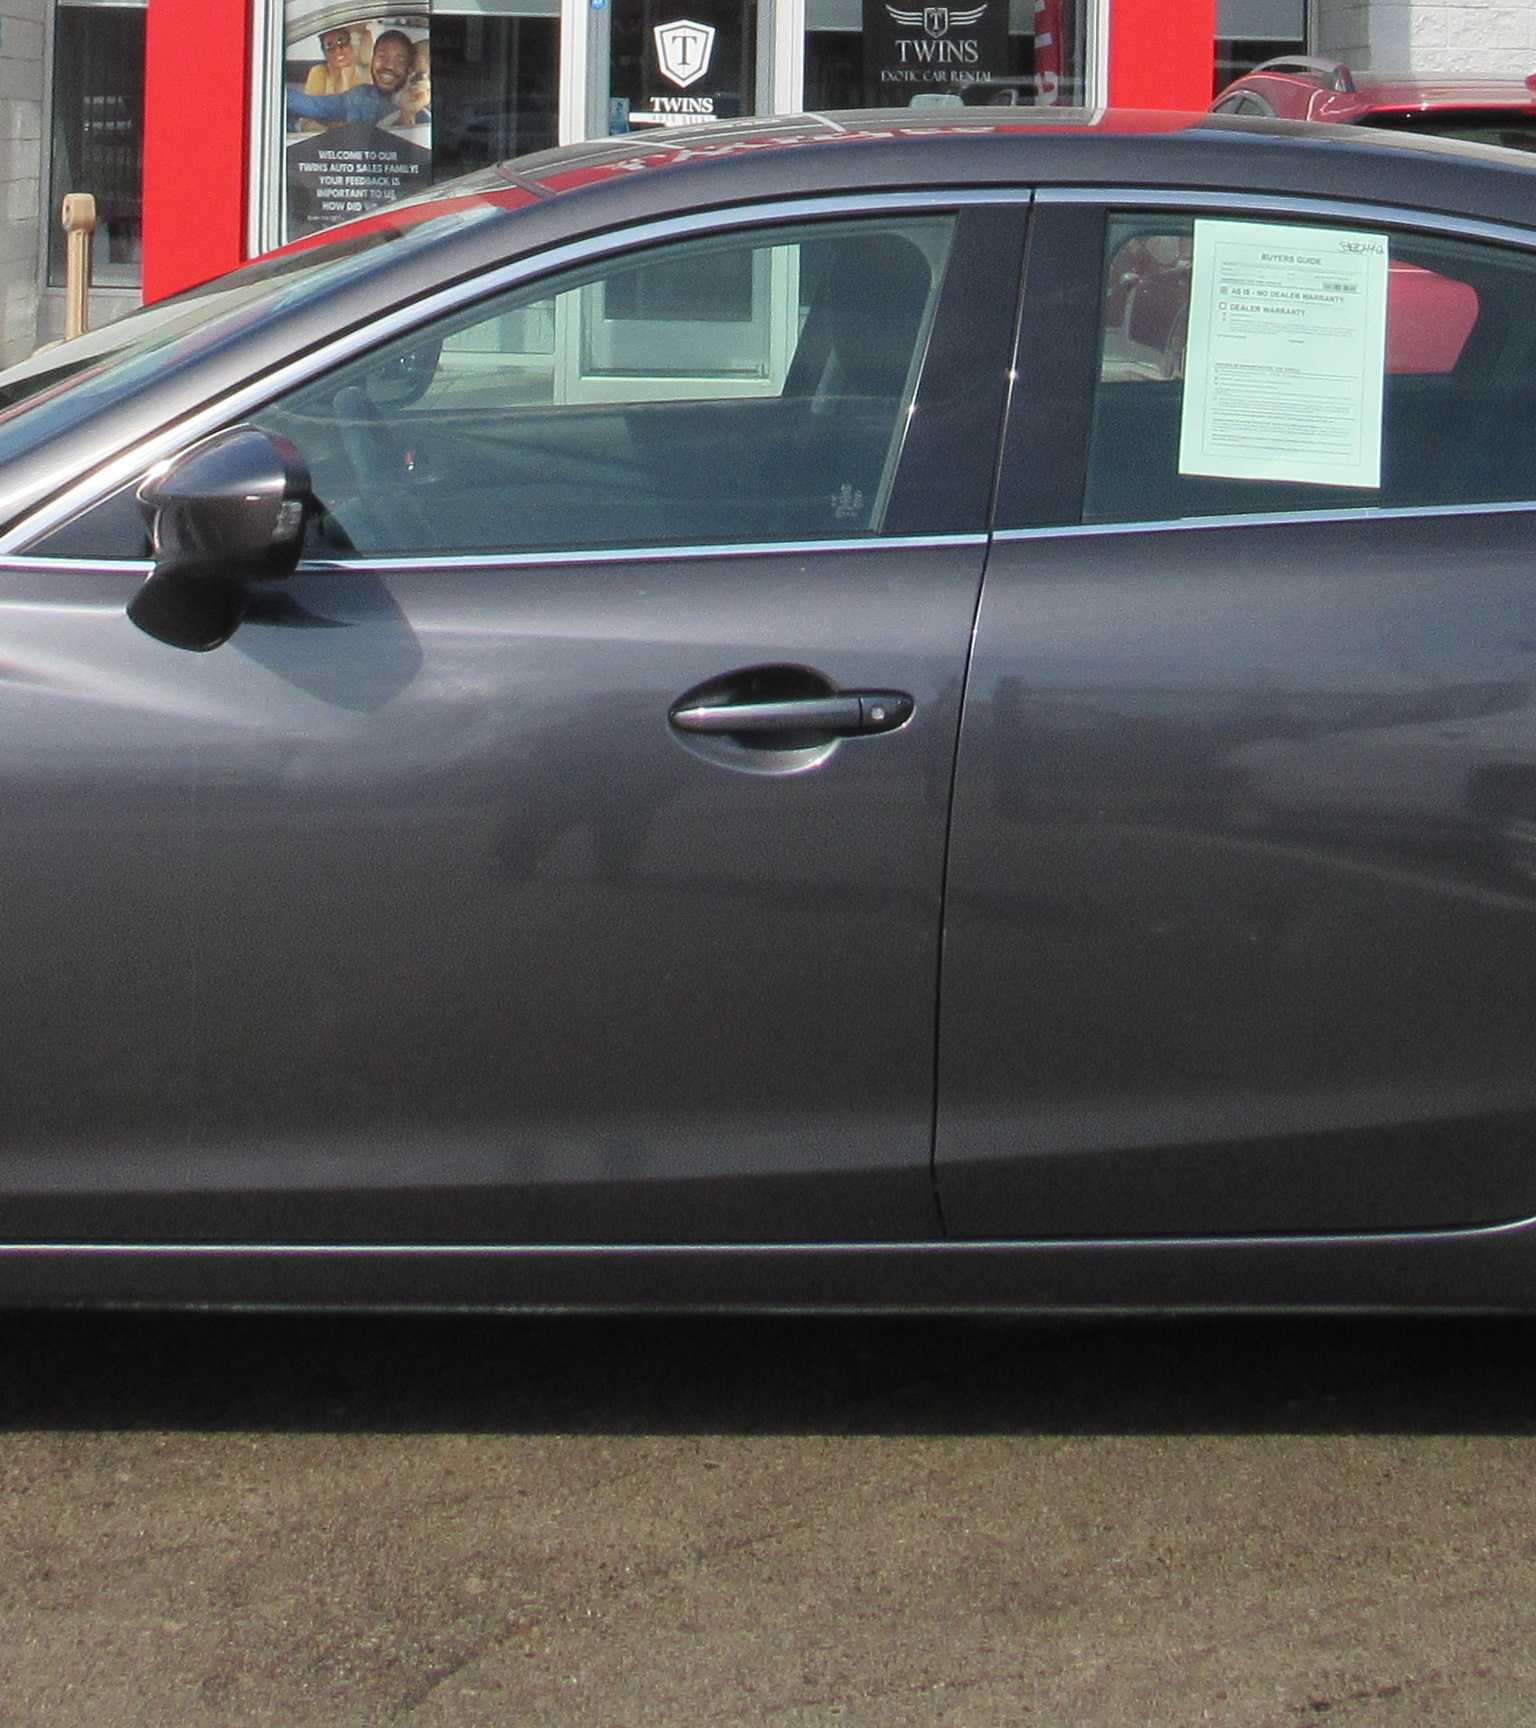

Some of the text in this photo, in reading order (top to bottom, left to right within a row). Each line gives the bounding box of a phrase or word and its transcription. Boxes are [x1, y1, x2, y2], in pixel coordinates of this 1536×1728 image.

[671, 35, 698, 66] T
[895, 39, 979, 63] TWINS
[881, 70, 992, 83] EXOTIC CAR RENTAL
[649, 97, 714, 113] TWINS
[318, 150, 398, 161] WELCOME TO OUR
[297, 162, 328, 173] TWINS
[329, 163, 354, 173] AUTO
[355, 164, 383, 174] SALES
[319, 175, 401, 186] YOUR FEEDBACK IS
[316, 188, 368, 199] IMPORTANT
[369, 189, 382, 199] TO
[321, 201, 345, 211] HOW
[346, 201, 363, 212] DID
[1261, 253, 1323, 266] BUYERS GUIDE
[1270, 291, 1301, 300] DEALER
[1302, 293, 1345, 303] WARRANTY
[1229, 303, 1307, 316] DEALER WARRANTY
